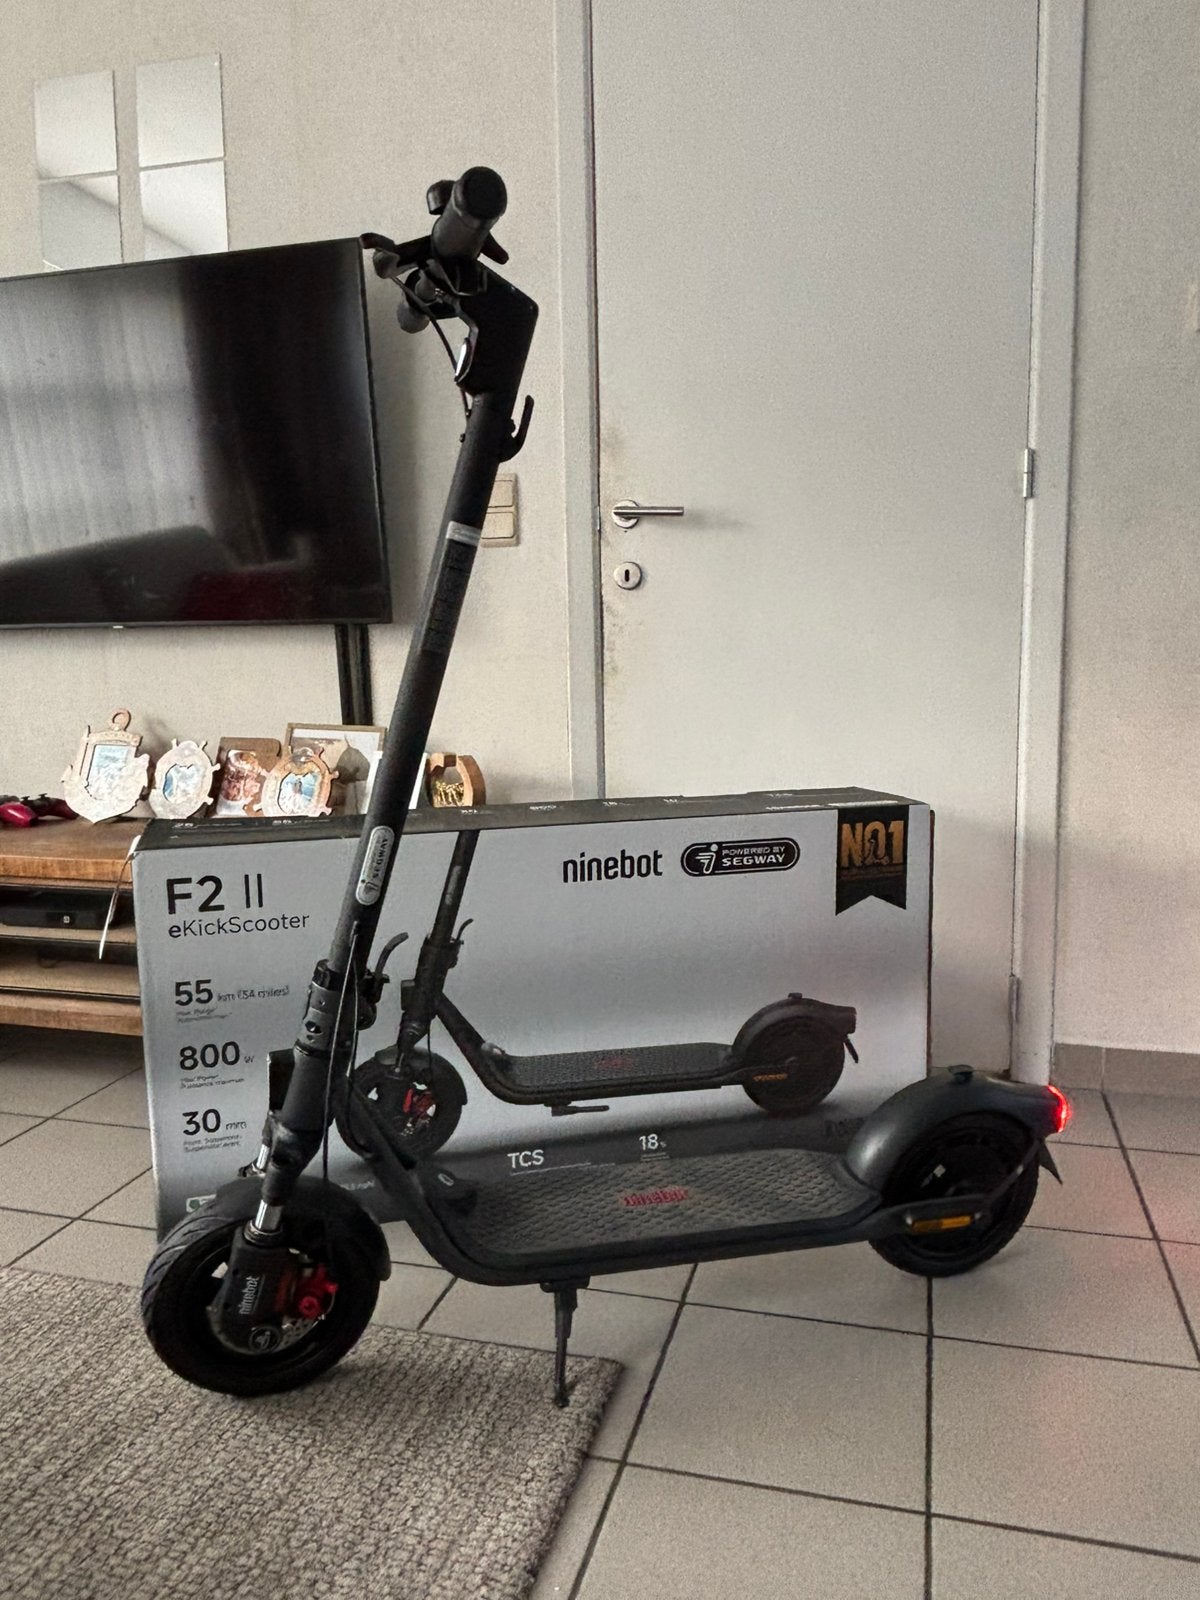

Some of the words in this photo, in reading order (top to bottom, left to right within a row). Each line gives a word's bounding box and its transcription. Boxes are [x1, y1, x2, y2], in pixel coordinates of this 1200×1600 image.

[722, 847, 771, 857] POWERED
[773, 846, 786, 854] BY
[722, 853, 786, 867] SEGWAY
[562, 849, 663, 884] ninebot
[166, 875, 225, 915] F2
[168, 914, 310, 938] eKickScooter
[175, 979, 213, 1006] 55
[180, 1041, 240, 1070] 800
[182, 1109, 221, 1136] 30
[639, 1134, 659, 1150] 18
[507, 1149, 545, 1168] TCS
[238, 1275, 260, 1315] ninebot
